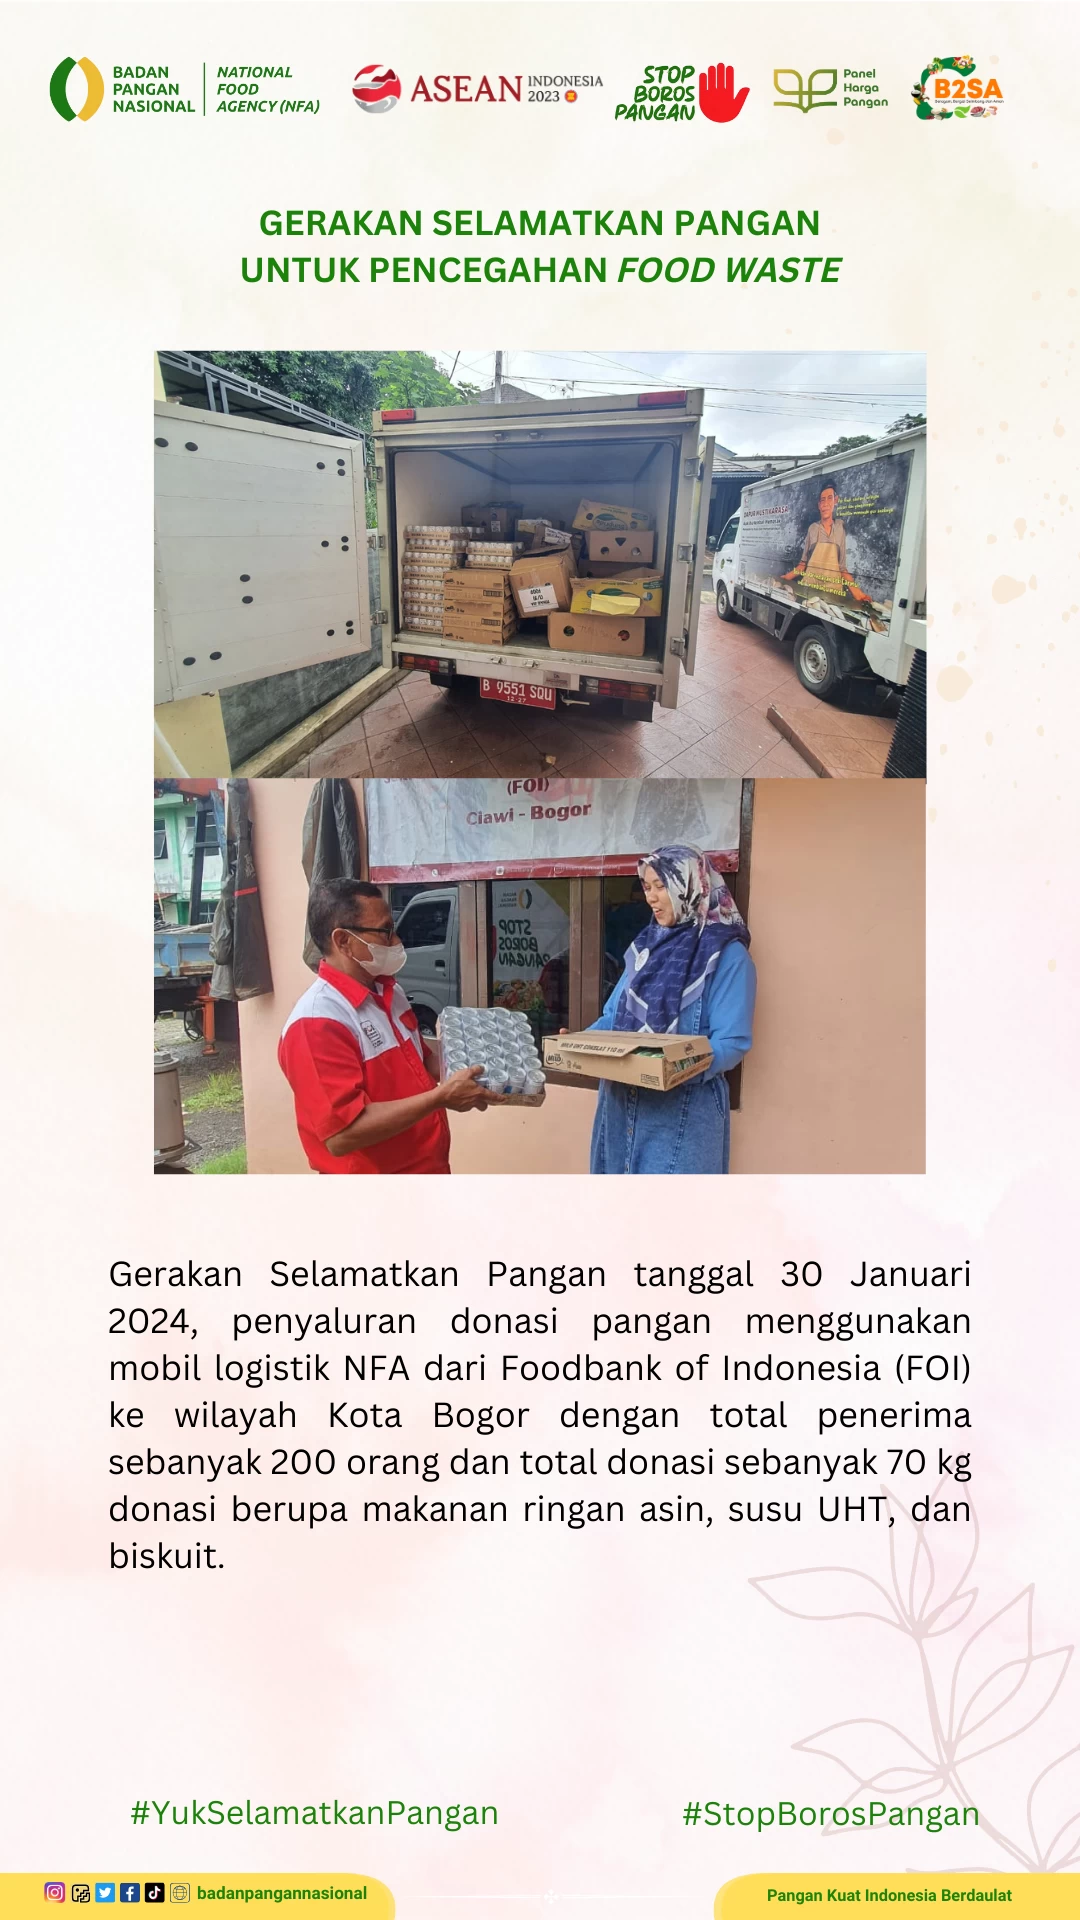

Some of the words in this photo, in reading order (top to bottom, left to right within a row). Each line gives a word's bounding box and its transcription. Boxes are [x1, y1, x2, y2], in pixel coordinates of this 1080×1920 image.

[482, 678, 491, 691] B
[496, 681, 526, 697] 9551
[529, 685, 553, 702] SQU
[507, 778, 550, 796] (FOI)
[466, 808, 514, 826] Ciawi
[530, 803, 592, 822] Bogor
